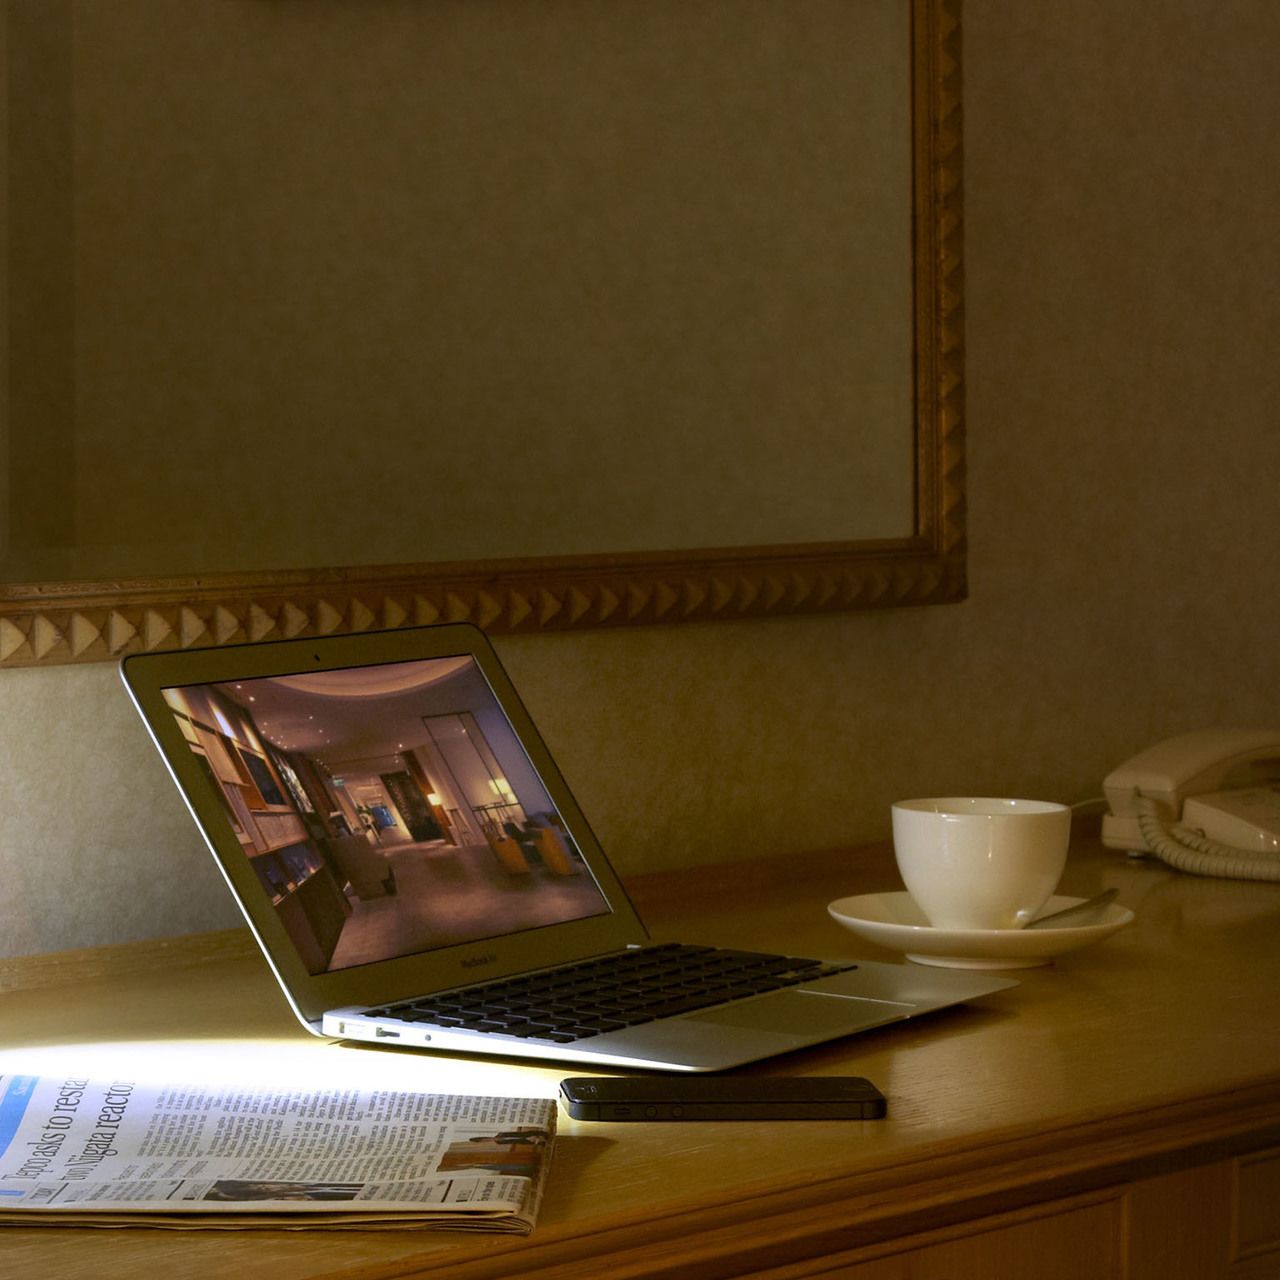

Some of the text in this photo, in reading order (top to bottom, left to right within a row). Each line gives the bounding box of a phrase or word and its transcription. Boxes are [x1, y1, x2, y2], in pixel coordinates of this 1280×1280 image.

[41, 1115, 74, 1132] to
[27, 1132, 67, 1157] asks
[64, 1132, 118, 1168] Niigata
[1, 1157, 54, 1181] Tepco
[56, 1166, 94, 1181] two
